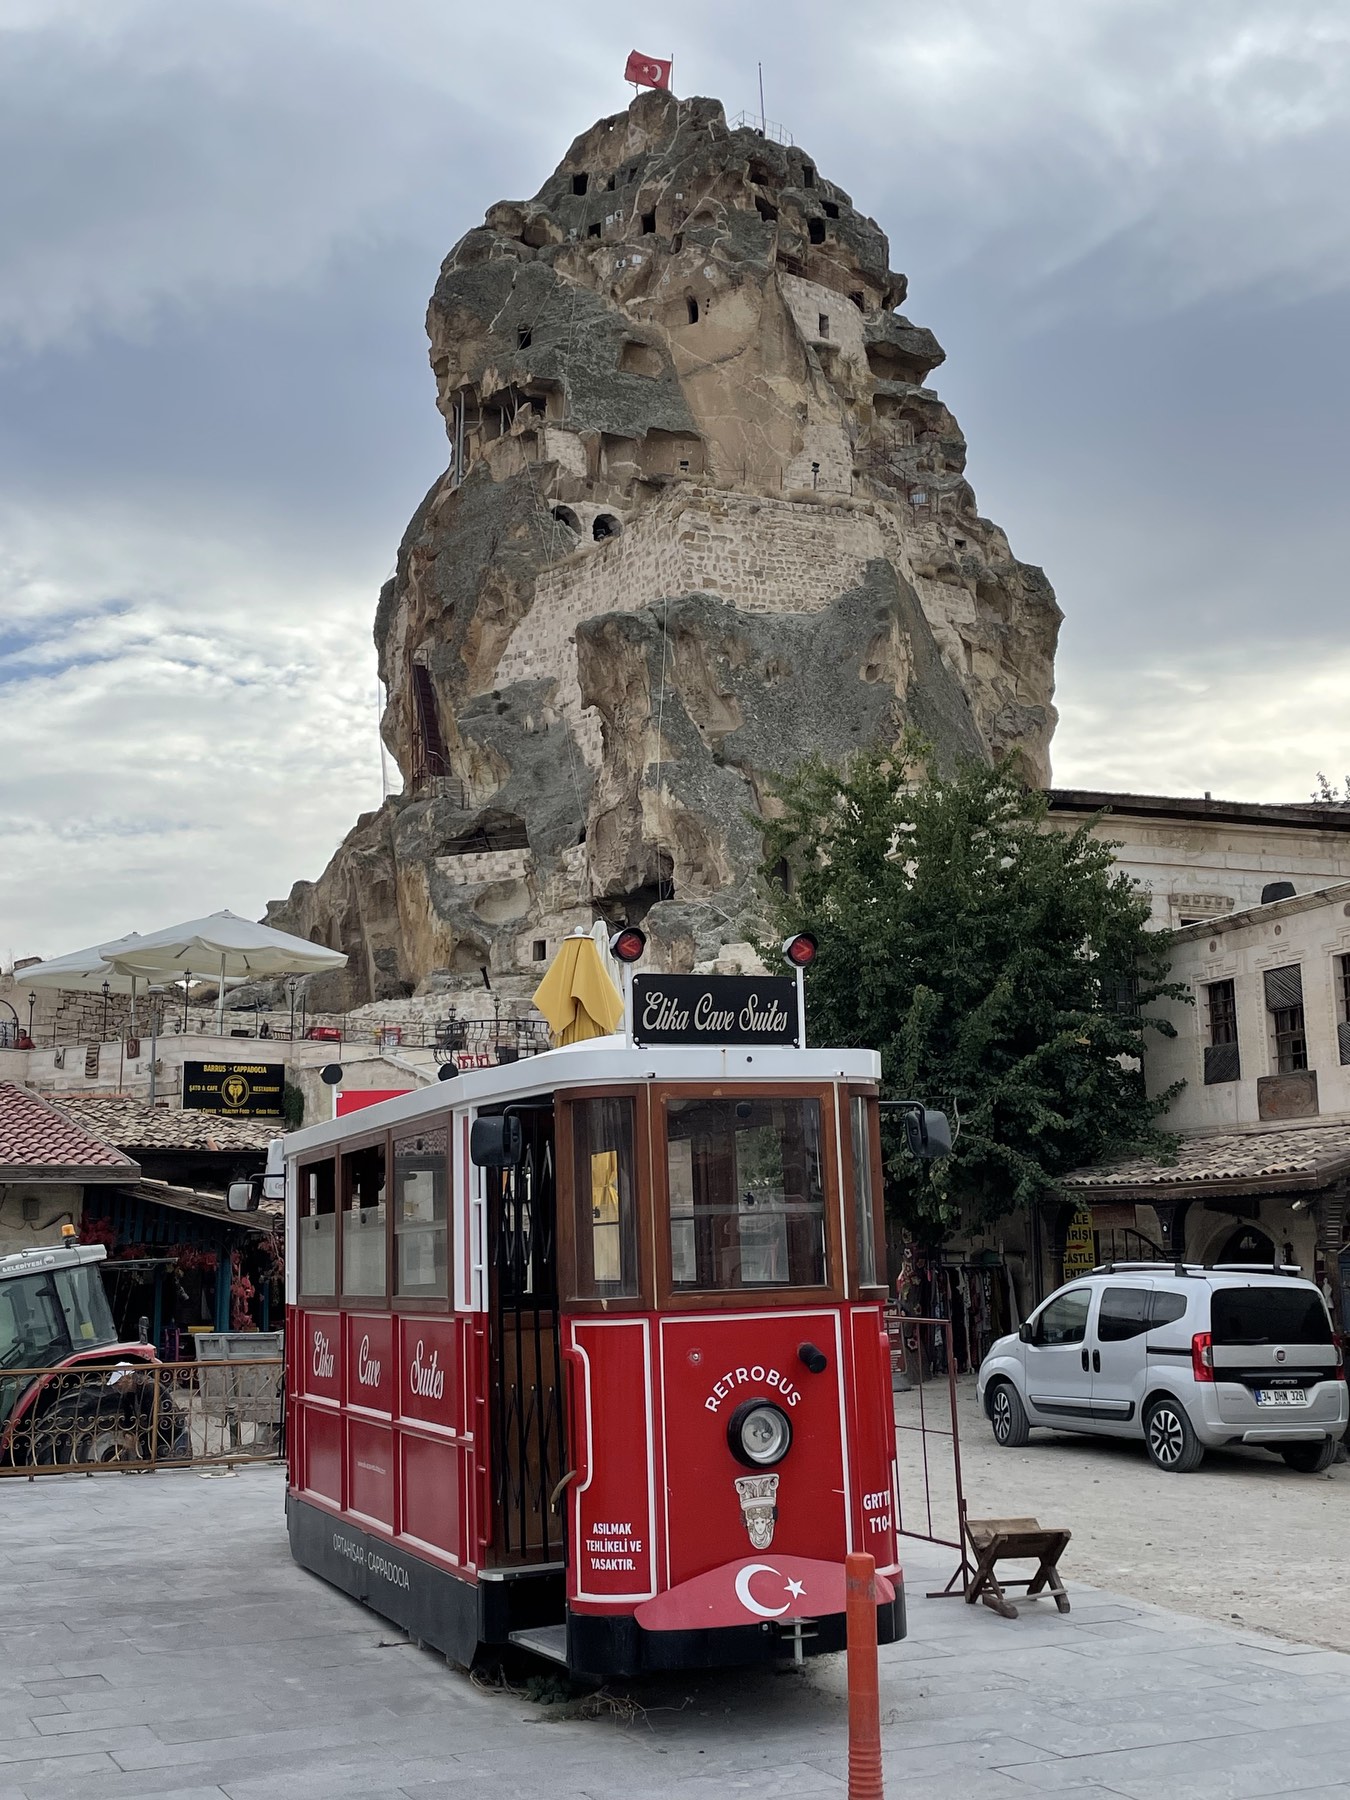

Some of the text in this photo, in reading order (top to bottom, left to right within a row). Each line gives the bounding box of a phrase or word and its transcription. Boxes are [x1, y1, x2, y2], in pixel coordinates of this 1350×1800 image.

[642, 991, 788, 1032] Elika Cave Suites
[203, 1064, 267, 1074] BARRUS CAPPADOCIA
[313, 1330, 445, 1400] Elika Cave Suites
[704, 1365, 802, 1413] RETROBUS
[1261, 1391, 1271, 1401] 34
[863, 1492, 883, 1510] GRT
[592, 1522, 632, 1535] ASILMAK
[585, 1537, 642, 1553] TEHLİKELİ VE
[590, 1557, 636, 1571] YASAKTIR.
